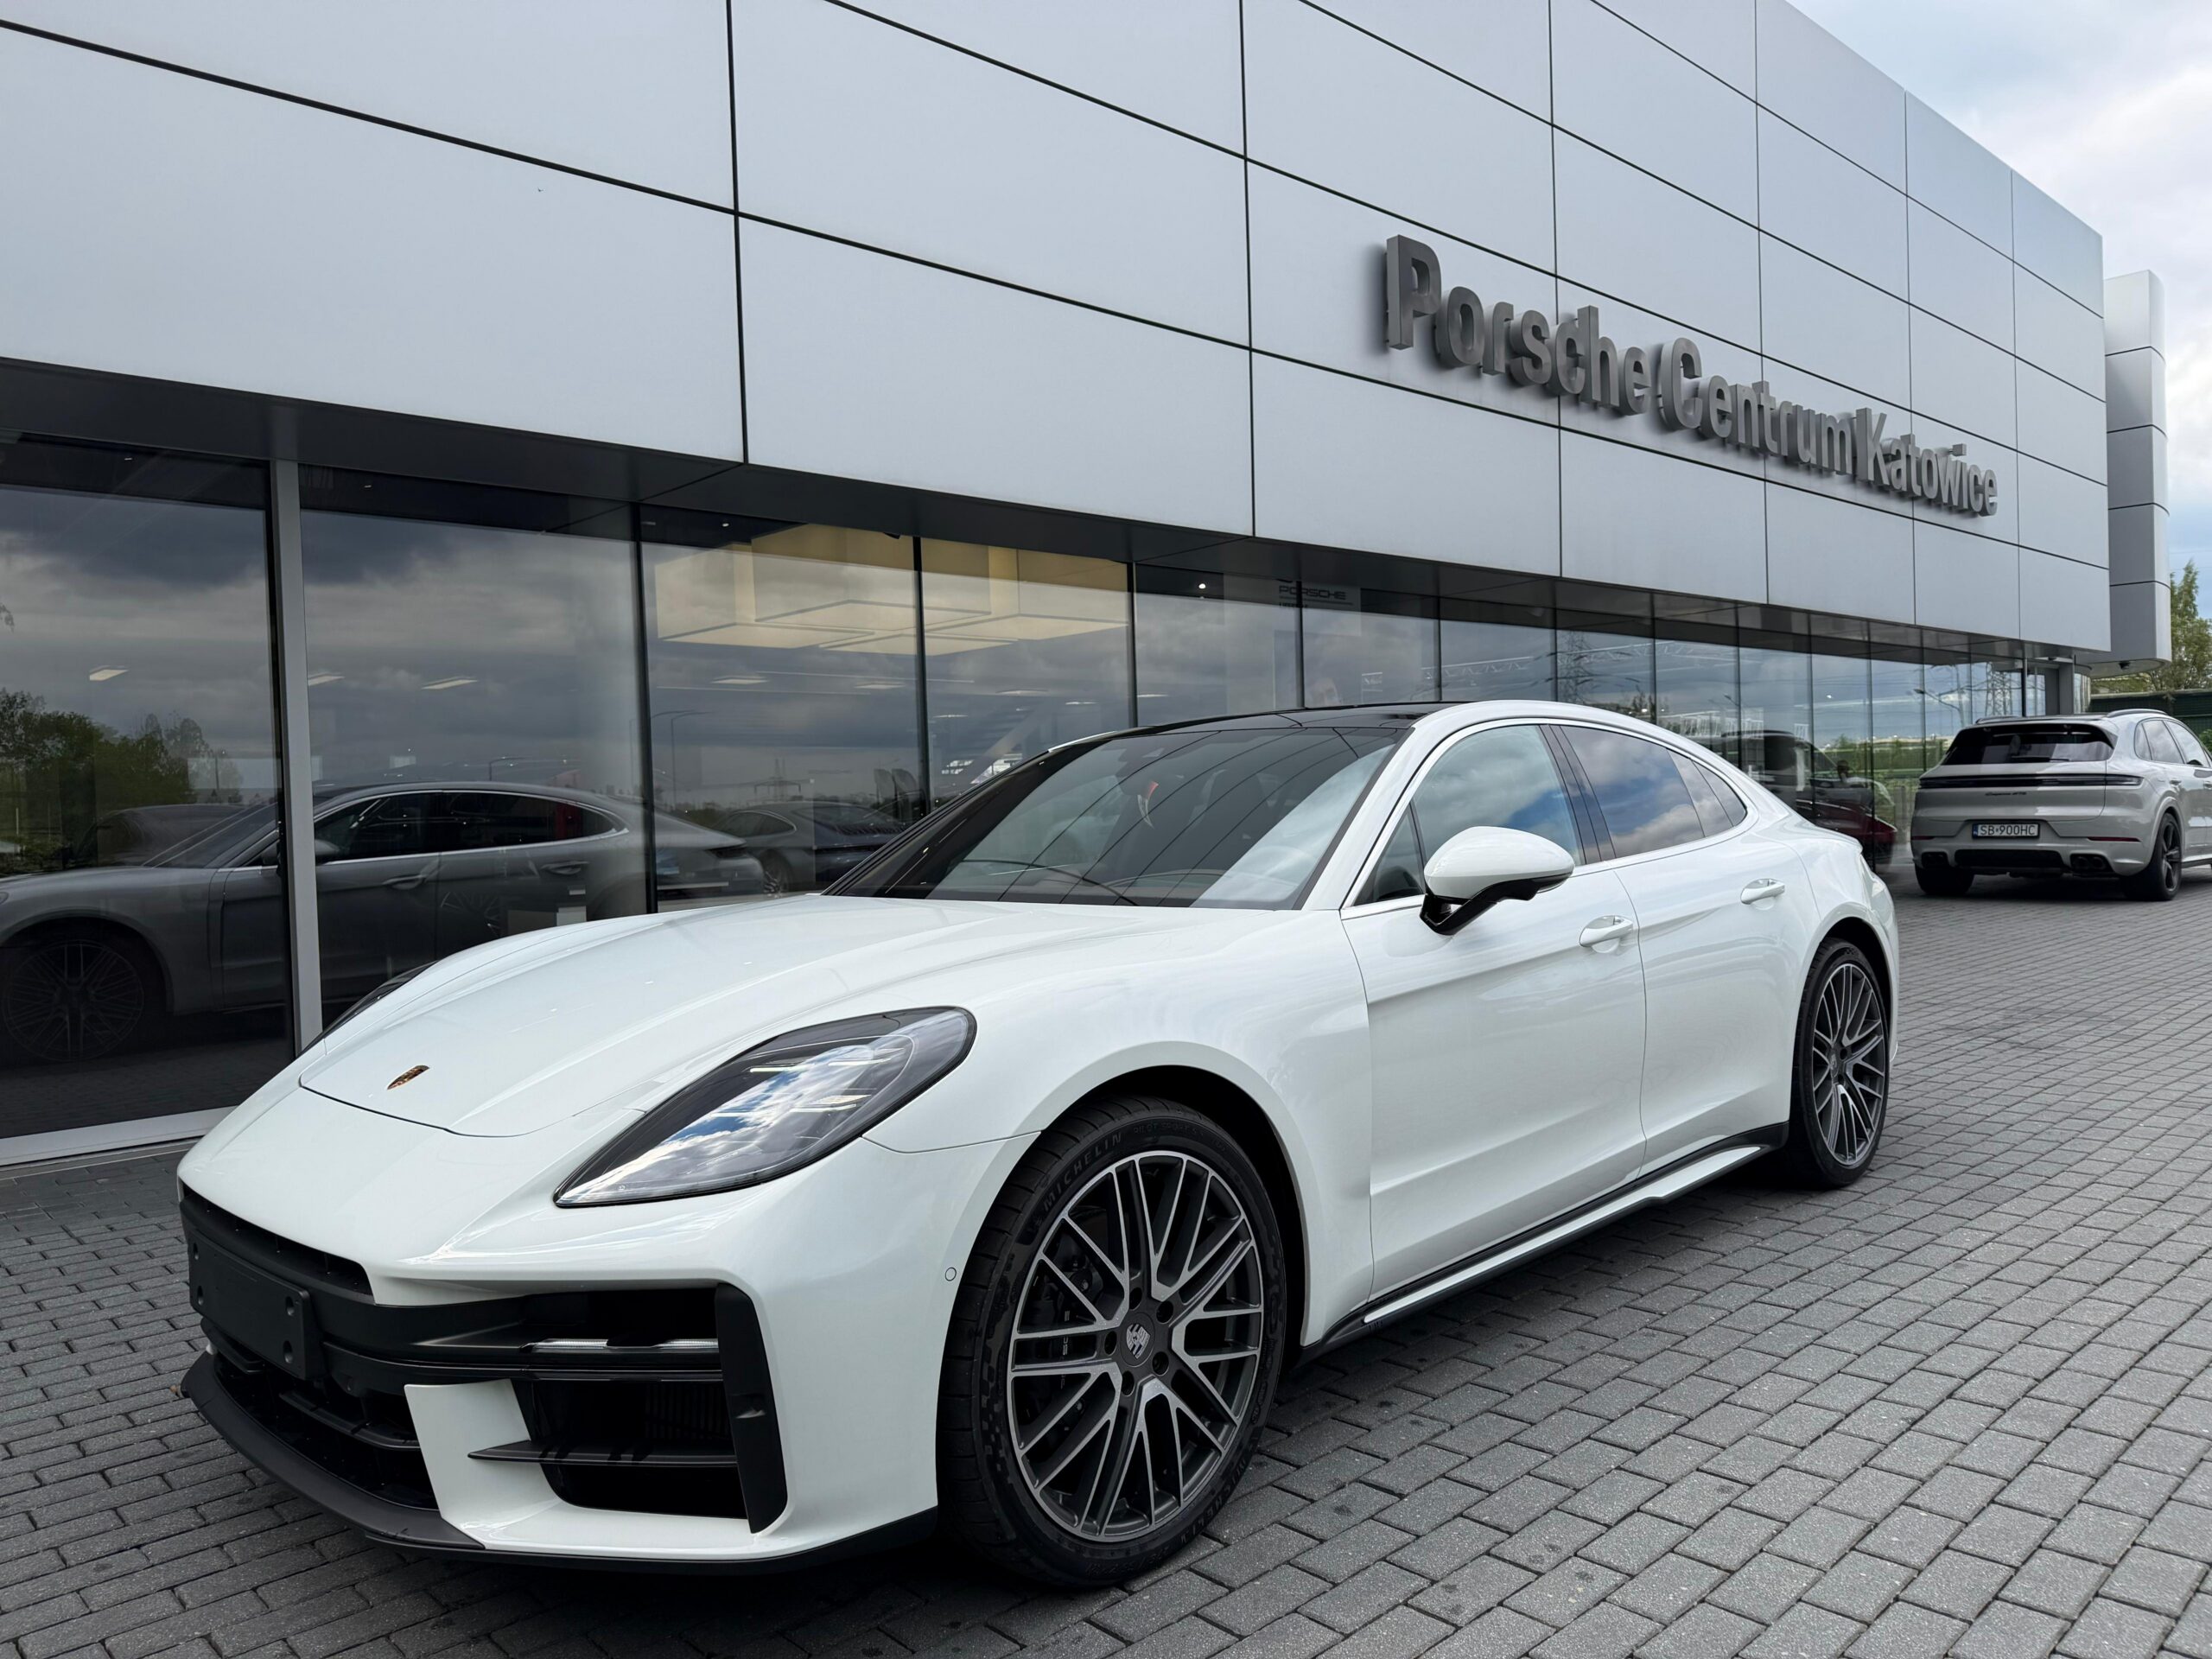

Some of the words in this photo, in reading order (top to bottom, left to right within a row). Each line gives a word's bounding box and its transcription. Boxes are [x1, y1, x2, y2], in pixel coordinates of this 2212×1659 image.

[1387, 234, 1649, 416] Porsche
[1660, 338, 1853, 476] Centrum
[1856, 407, 1998, 517] Katowice
[1043, 1131, 1122, 1212] MICHELIN
